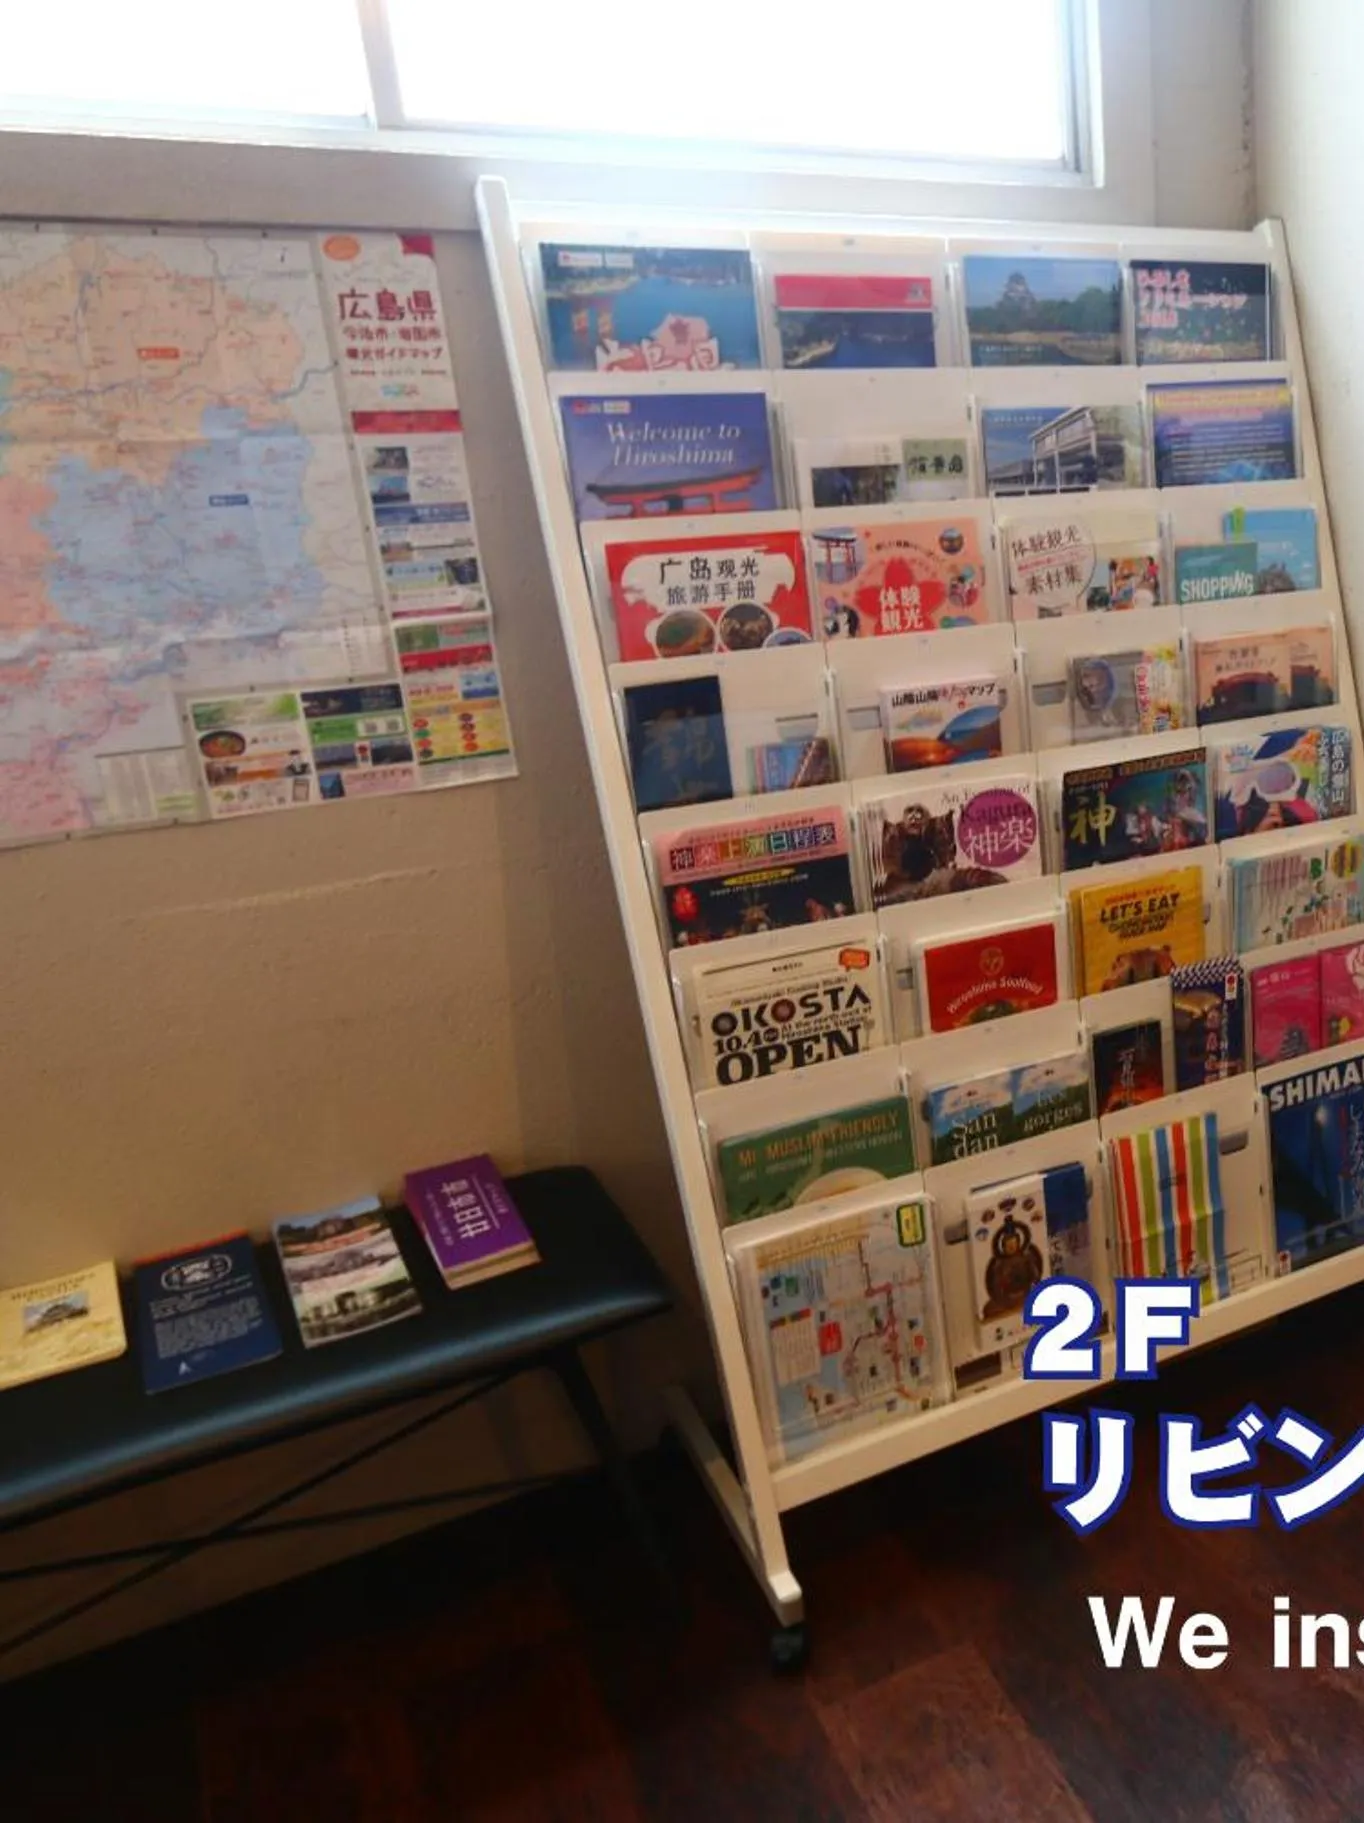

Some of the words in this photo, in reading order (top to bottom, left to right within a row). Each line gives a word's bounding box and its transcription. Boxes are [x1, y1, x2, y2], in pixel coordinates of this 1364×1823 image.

[338, 288, 437, 321] 広島県
[607, 422, 710, 444] Welcome
[718, 422, 741, 439] to
[613, 443, 734, 467] Hiroshima
[1011, 524, 1082, 559] 体験観光
[658, 555, 760, 585] 广岛观光
[1026, 564, 1084, 596] 素材集
[666, 581, 757, 606] 旅游手册
[1179, 571, 1255, 602] SHOPPING
[966, 815, 1034, 864] 神楽
[1100, 900, 1143, 923] LET'S
[1148, 892, 1180, 913] EAT
[711, 983, 871, 1037] OKOSTA
[713, 1029, 762, 1055] 10.4
[716, 1025, 861, 1086] OPEN
[951, 1109, 997, 1141] San
[953, 1130, 1000, 1161] dan
